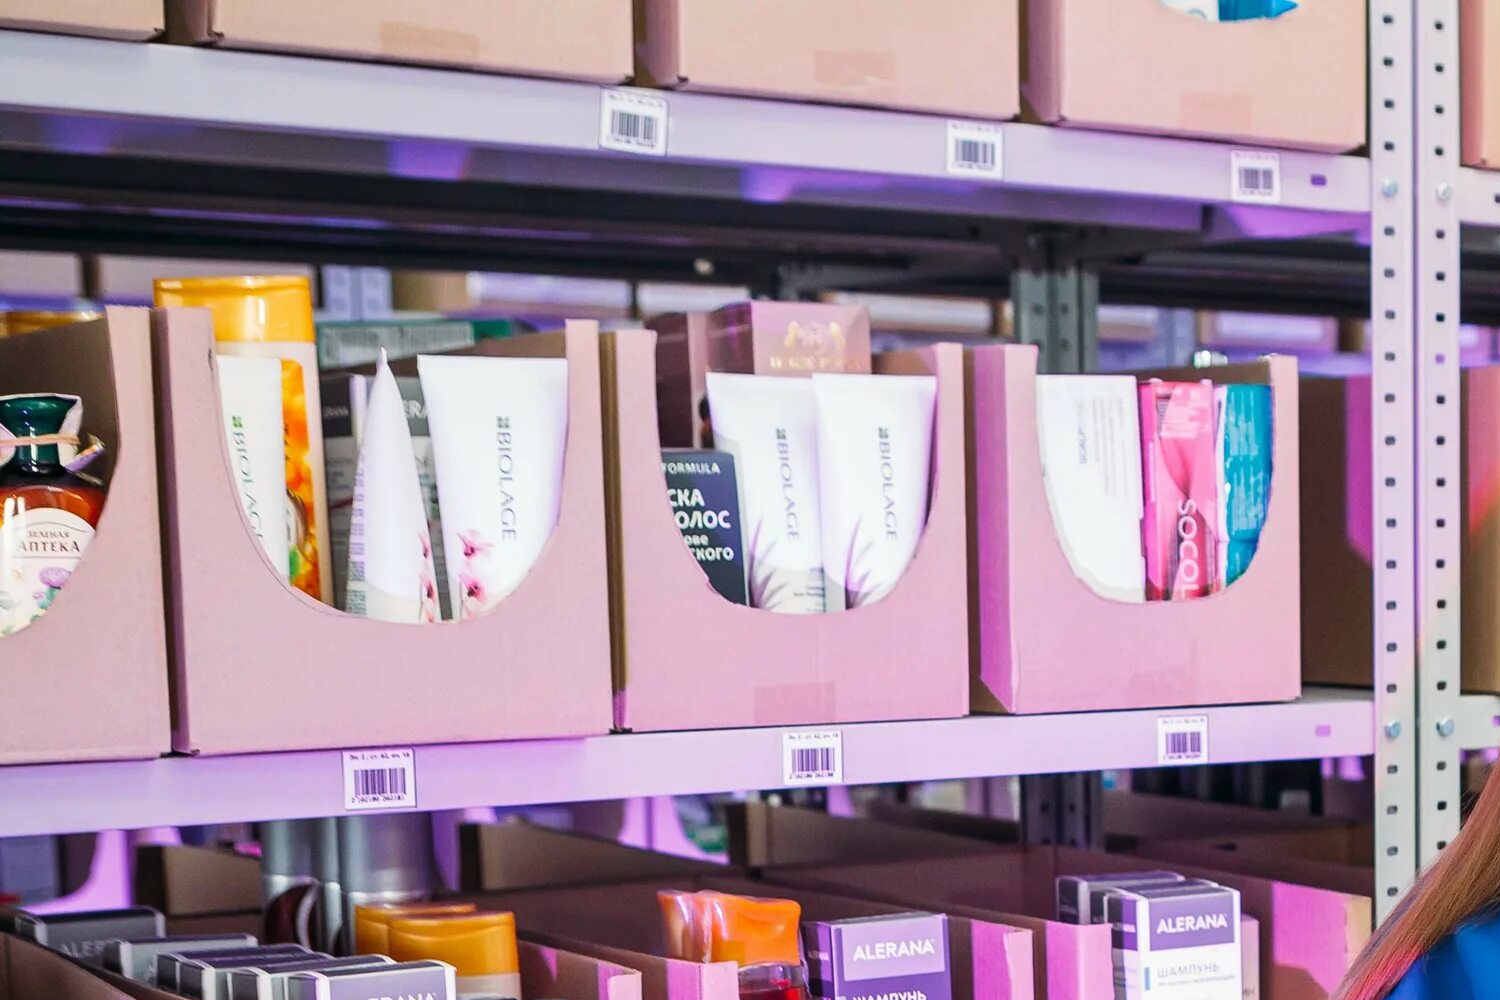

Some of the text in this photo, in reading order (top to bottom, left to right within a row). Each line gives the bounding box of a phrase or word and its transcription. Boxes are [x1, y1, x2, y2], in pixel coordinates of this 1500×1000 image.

[497, 431, 518, 540] BIOLAGE
[776, 443, 799, 541] BIOLAGE
[878, 442, 897, 541] BIOLAGE
[1178, 499, 1199, 599] SOCOL
[853, 940, 935, 961] ALERANA
[1157, 914, 1227, 934] ALERANA
